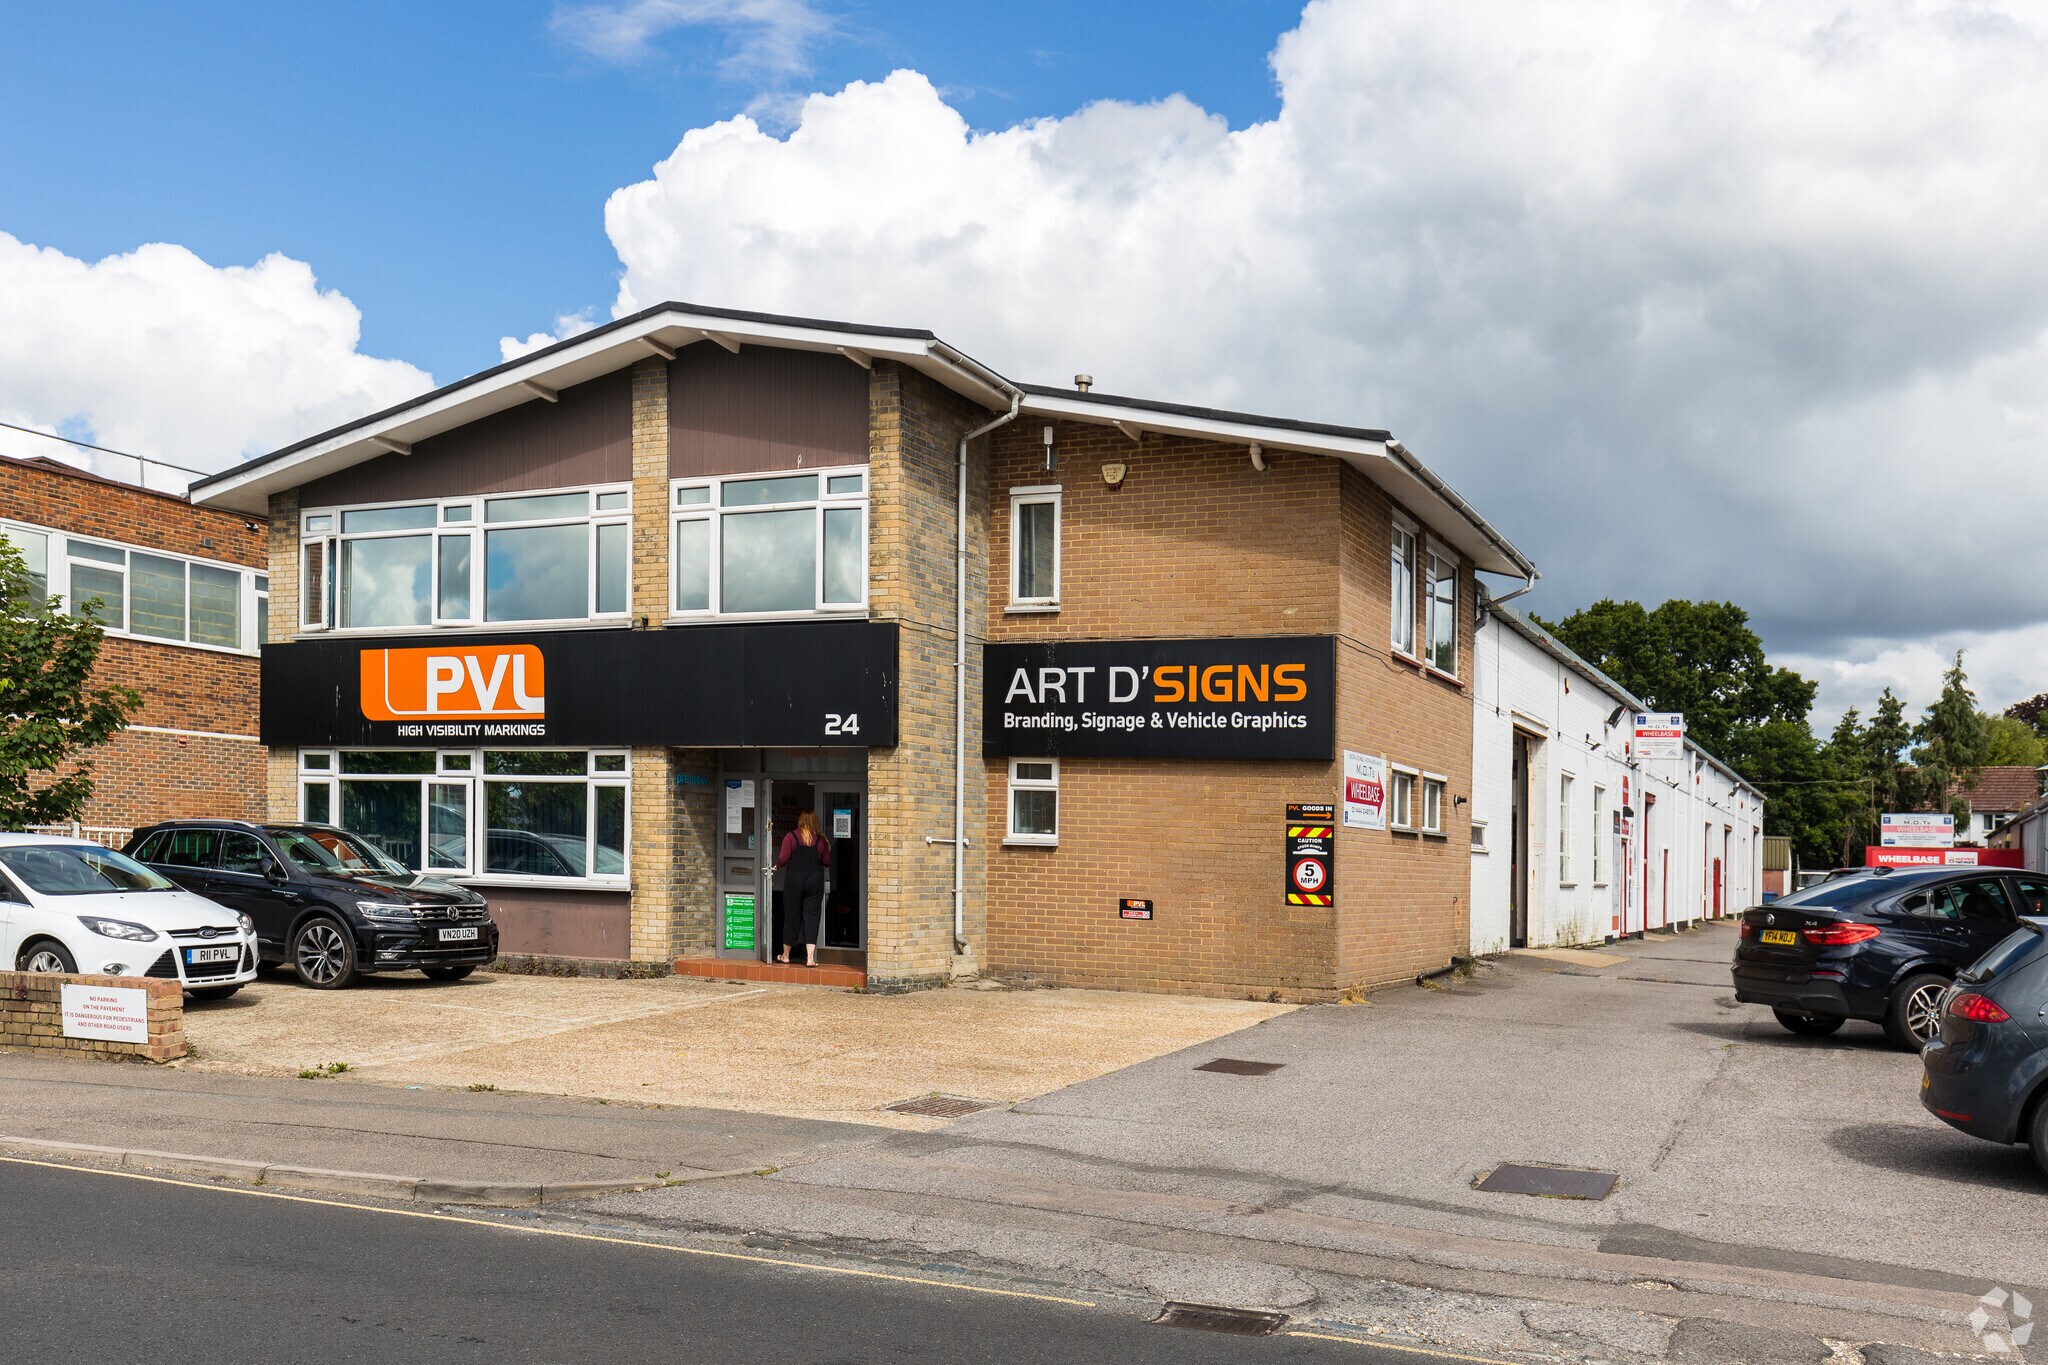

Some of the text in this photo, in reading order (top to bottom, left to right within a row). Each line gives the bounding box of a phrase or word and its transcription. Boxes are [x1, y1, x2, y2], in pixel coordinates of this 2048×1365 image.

[427, 654, 545, 713] PVL
[1005, 666, 1096, 704] ART
[825, 713, 860, 735] 24
[1004, 711, 1308, 732] Branding, Signage & Vehicle Graphics
[397, 723, 546, 737] HIGH VISIBILITY MARKINGS
[676, 773, 709, 786] preview
[1350, 782, 1380, 803] WHEELBASE
[1878, 854, 1940, 864] WHEELBASE
[1304, 864, 1315, 877] 5
[442, 929, 476, 939] VN20 UZH
[213, 949, 230, 960] PVL
[97, 996, 118, 1004] PARKING
[100, 1005, 125, 1013] PAVEMENT
[75, 1012, 102, 1020] DANGEROUS
[113, 1015, 145, 1024] PEDESTRIANS
